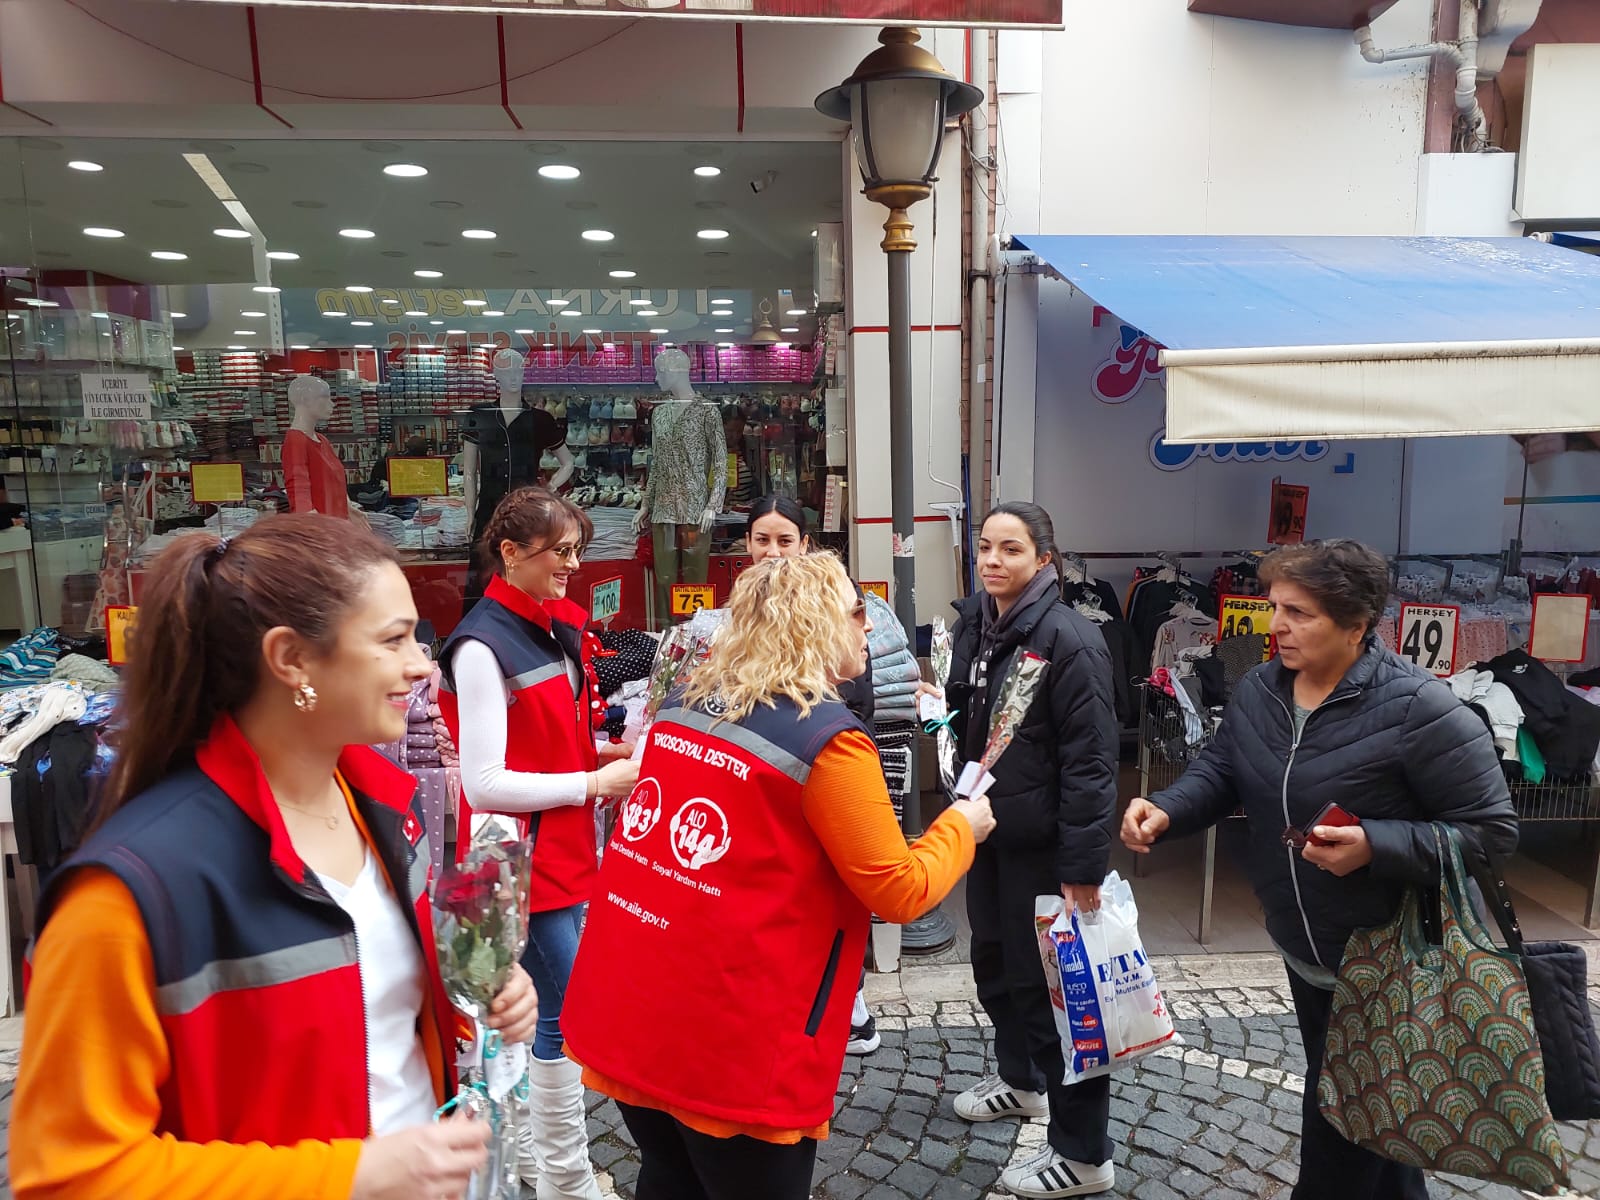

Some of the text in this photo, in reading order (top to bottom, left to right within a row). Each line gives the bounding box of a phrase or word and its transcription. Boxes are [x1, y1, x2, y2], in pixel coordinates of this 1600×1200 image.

[601, 592, 616, 615] 100
[679, 594, 704, 610] 75
[1407, 607, 1454, 618] HERŞEY
[1402, 619, 1443, 669] 49
[703, 748, 751, 781] DESTEK
[636, 789, 649, 805] ALO
[685, 808, 707, 830] ALO
[678, 824, 716, 858] 144
[651, 860, 721, 897] Sosyal Yardım Hattı
[607, 890, 670, 930] www.aile.gov.tr
[1115, 972, 1143, 987] A.V.M.
[1115, 984, 1141, 996] Mutfak
